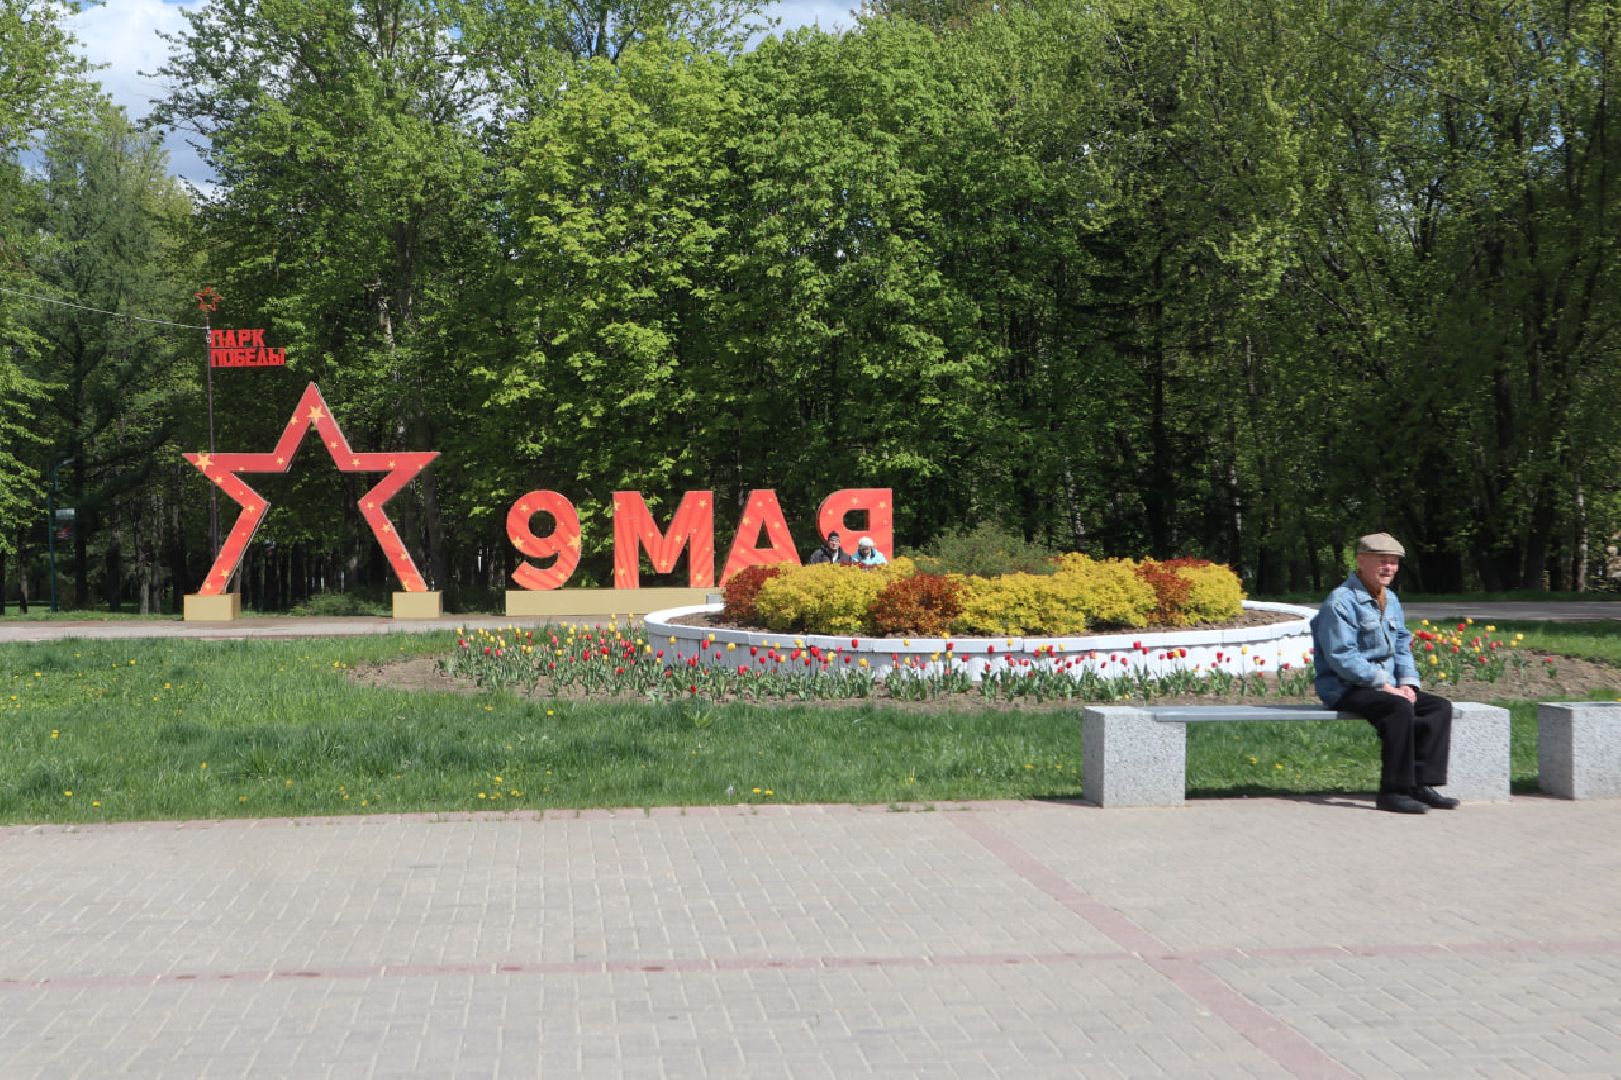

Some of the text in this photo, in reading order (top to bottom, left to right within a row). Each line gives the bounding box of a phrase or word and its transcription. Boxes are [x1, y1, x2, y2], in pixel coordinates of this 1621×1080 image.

[210, 329, 265, 348] ПАРК
[210, 348, 286, 367] ПОБЕДЫ
[506, 487, 893, 591] 9 МАЯ
